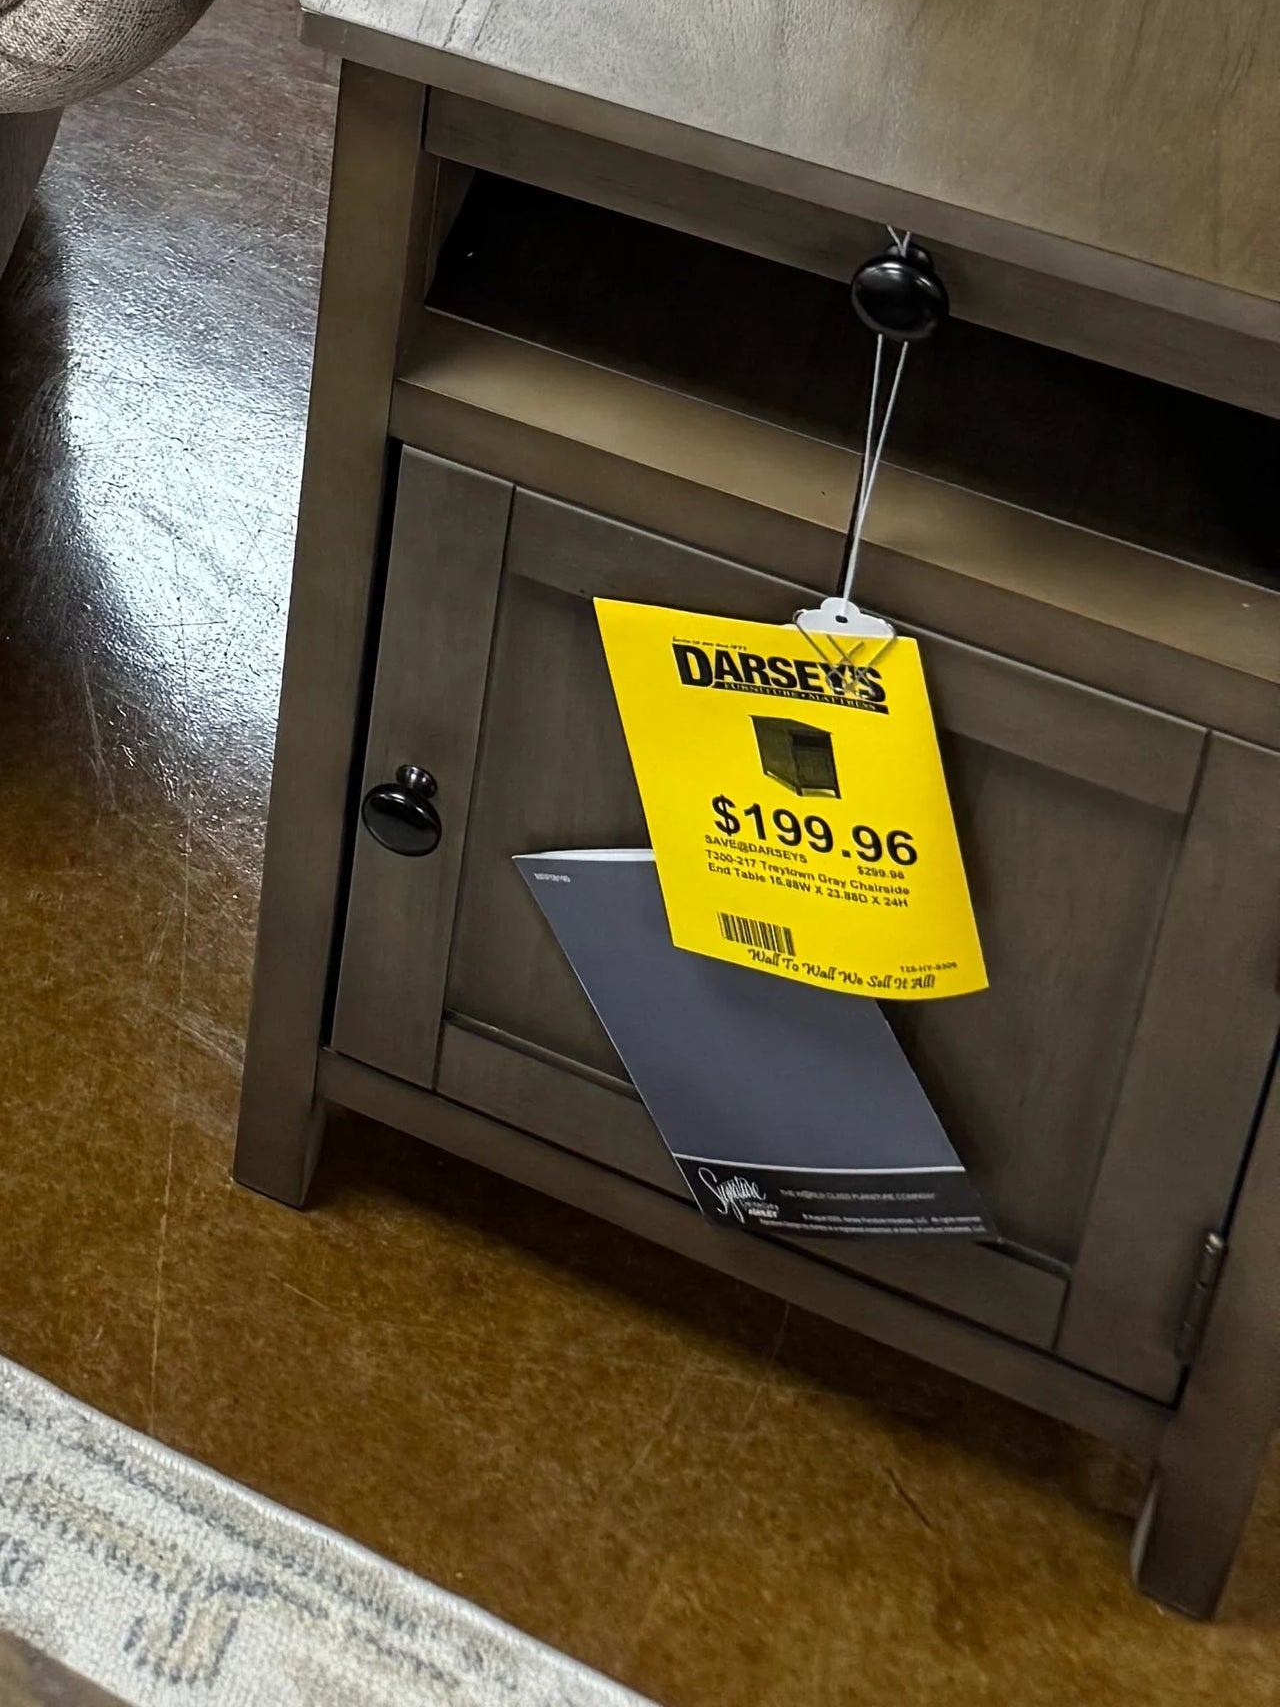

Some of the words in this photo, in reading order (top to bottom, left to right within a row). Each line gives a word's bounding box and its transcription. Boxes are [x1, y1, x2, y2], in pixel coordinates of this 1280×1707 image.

[705, 834, 808, 864] SAVE@DARSEYS
[712, 794, 918, 866] $199.96
[705, 849, 756, 868] T300-217
[818, 873, 847, 889] Gray
[850, 879, 910, 895] Chairside
[708, 862, 731, 875] End
[733, 867, 766, 882] Table
[814, 885, 823, 895] X
[871, 895, 881, 905] X
[884, 897, 908, 907] 24H
[748, 948, 781, 967] Wall
[782, 958, 799, 972] To
[802, 963, 837, 981] Wall
[839, 970, 863, 985] We
[866, 974, 892, 989] Sell
